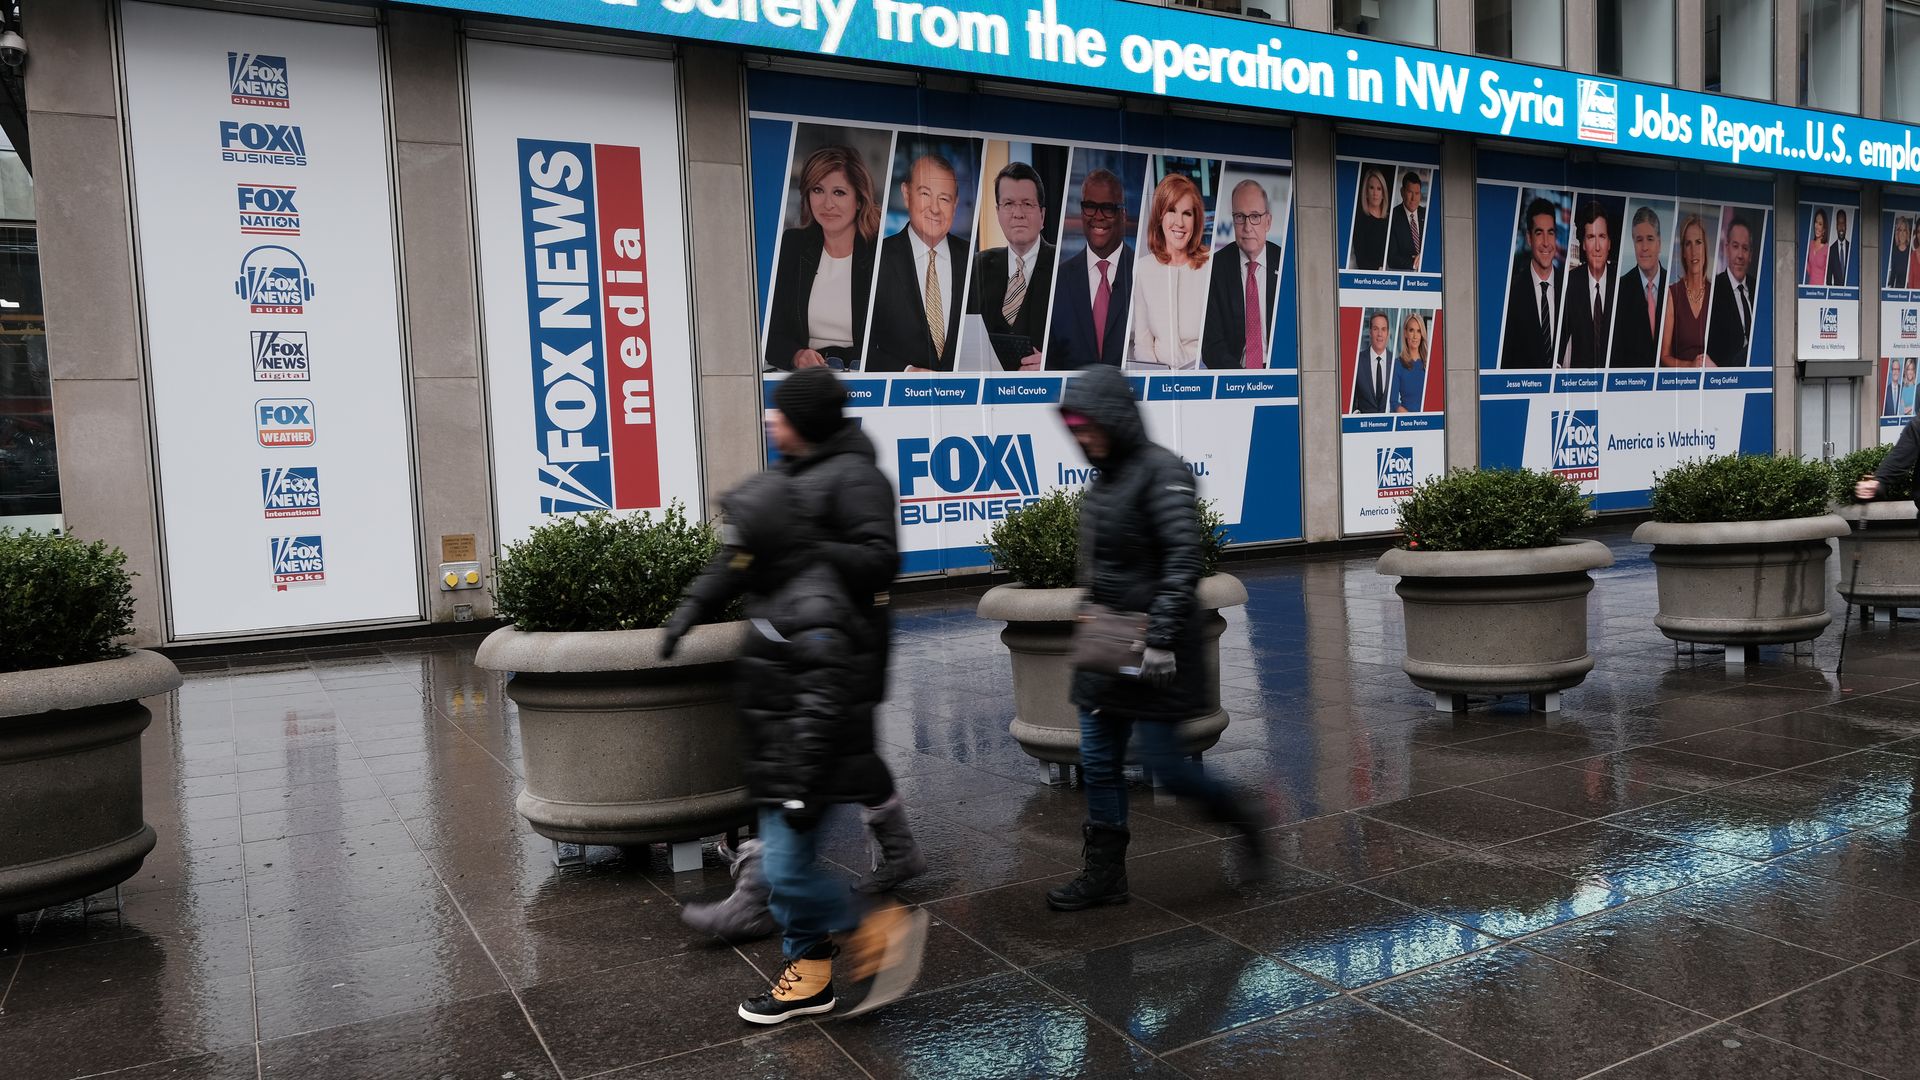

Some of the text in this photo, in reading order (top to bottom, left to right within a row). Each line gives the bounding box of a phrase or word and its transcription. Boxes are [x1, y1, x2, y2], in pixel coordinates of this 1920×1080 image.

[248, 65, 285, 82] FOX
[873, 0, 1009, 56] from
[1025, 0, 1107, 67] the
[1120, 37, 1334, 94] operation
[1347, 49, 1383, 104] in
[1396, 56, 1469, 115] NW
[1480, 71, 1564, 134] Syria
[239, 80, 288, 97] NEWS
[233, 97, 288, 107] channel
[1628, 93, 1692, 144] Jobs
[220, 121, 293, 151] FOX
[222, 152, 307, 166] BUSINESS
[238, 187, 298, 212] FOX
[240, 215, 300, 228] NATION
[266, 277, 299, 291] FOX
[257, 291, 301, 304] NEWS
[528, 150, 600, 463] FOX NEWS
[607, 228, 651, 425] media
[271, 343, 304, 356] FOX
[262, 357, 307, 369] NEWS
[1162, 384, 1172, 392] Liz
[1226, 382, 1274, 393] Larry Kudlow
[1506, 380, 1521, 388] Jesse
[1578, 378, 1598, 386] Carlson
[1628, 378, 1647, 387] Hannity
[846, 390, 872, 398] romo
[904, 387, 966, 398] Stuart Varney
[998, 386, 1047, 395] Neil Cavuto
[260, 405, 310, 425] FOX
[262, 432, 311, 443] WEATHER
[1567, 425, 1597, 446] FOX
[1607, 429, 1716, 450] America is Watching
[1558, 446, 1599, 467] NEWS
[897, 434, 1019, 496] FOX
[1058, 462, 1100, 486] Inve
[1181, 455, 1210, 477] ou.
[1389, 457, 1412, 473] FOX
[281, 478, 317, 493] FOX
[1382, 472, 1413, 487] NEWS
[271, 492, 319, 507] NEWS
[1378, 489, 1413, 497] channe
[266, 509, 320, 518] international
[1359, 504, 1396, 517] America is
[289, 546, 321, 560] FOX
[280, 559, 322, 573] NEWS
[276, 574, 322, 583] books
